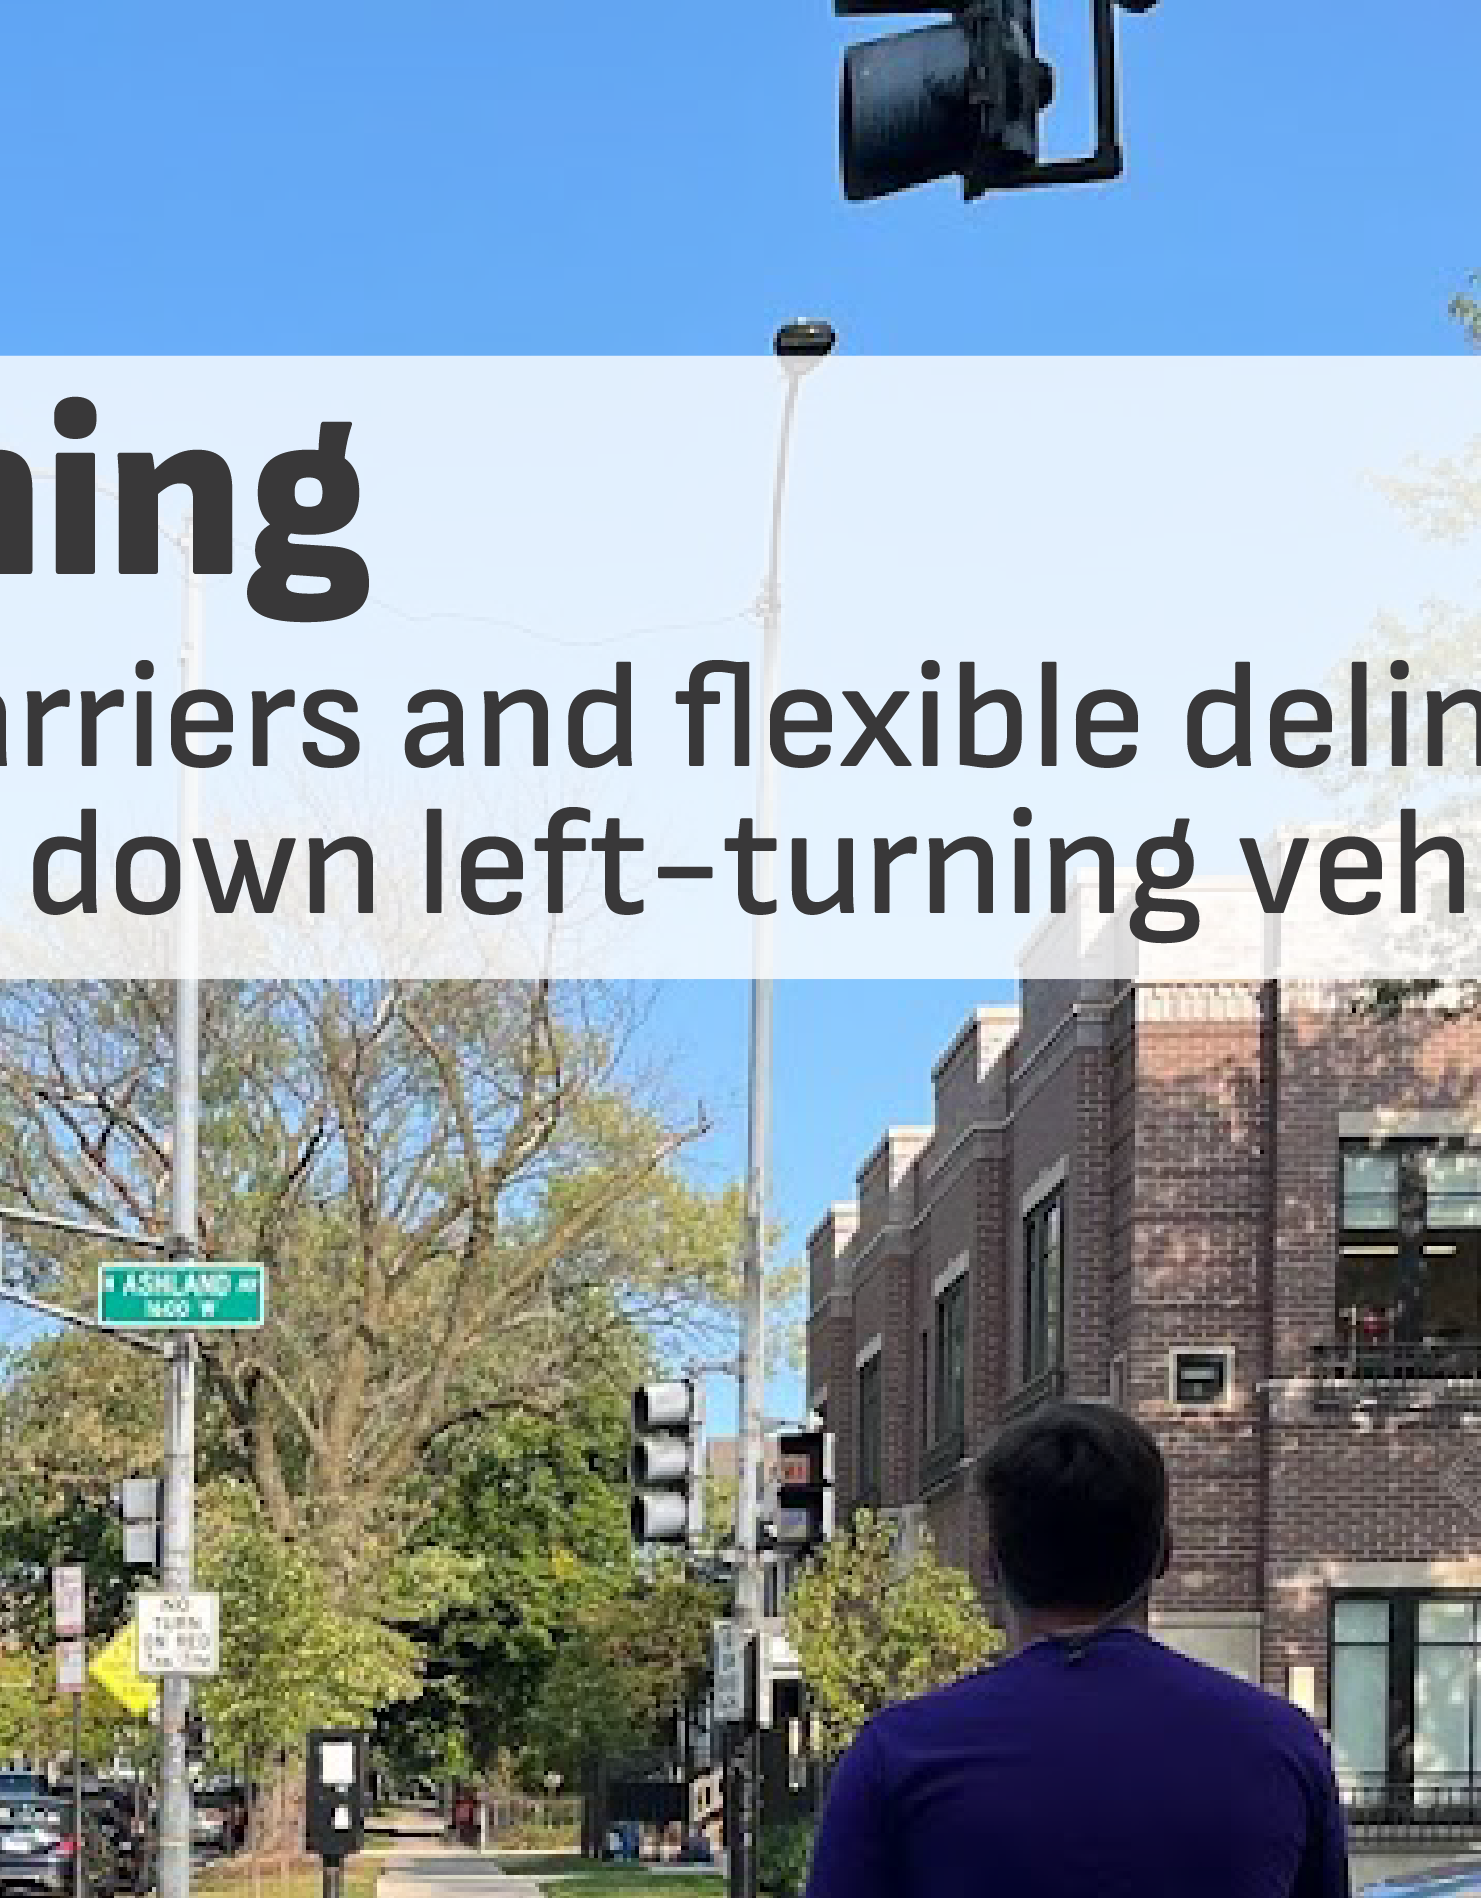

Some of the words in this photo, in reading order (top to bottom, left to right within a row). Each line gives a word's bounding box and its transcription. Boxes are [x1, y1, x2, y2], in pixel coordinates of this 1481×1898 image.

[123, 1273, 231, 1297] ASHLAND
[160, 1599, 190, 1612] NO
[152, 1616, 203, 1631] TURN
[143, 1633, 166, 1650] ON
[176, 1633, 211, 1650] RED
